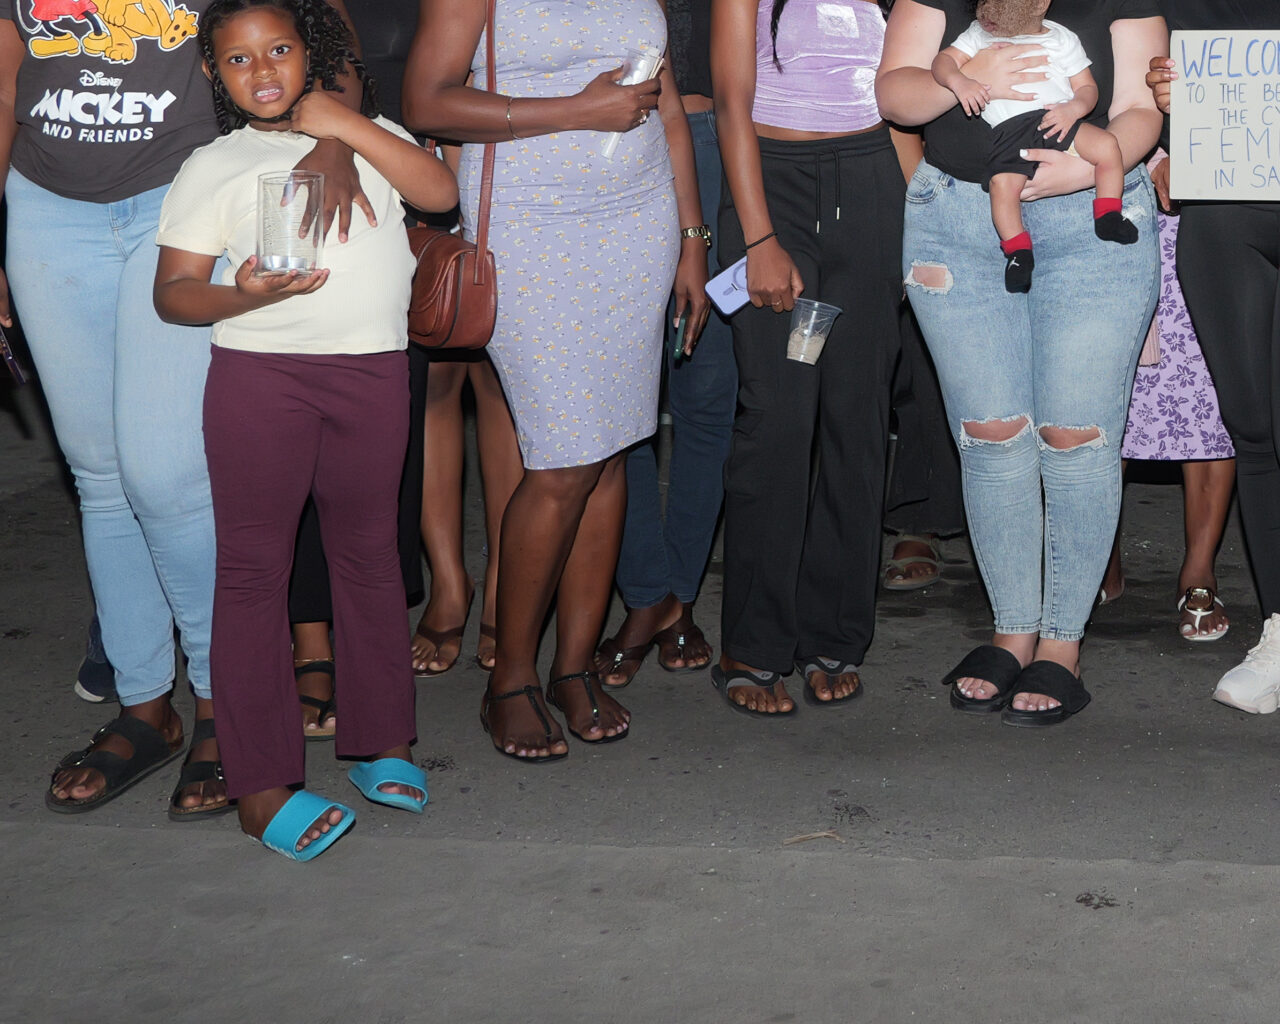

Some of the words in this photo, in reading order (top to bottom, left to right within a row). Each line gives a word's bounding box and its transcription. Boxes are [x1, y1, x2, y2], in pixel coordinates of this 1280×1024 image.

[1186, 82, 1205, 104] TO
[1219, 83, 1247, 104] THE
[30, 87, 177, 126] MICKEY
[1219, 108, 1248, 125] THE
[42, 121, 73, 140] AND
[78, 127, 154, 142] FRIENDS
[1214, 168, 1235, 189] IN
